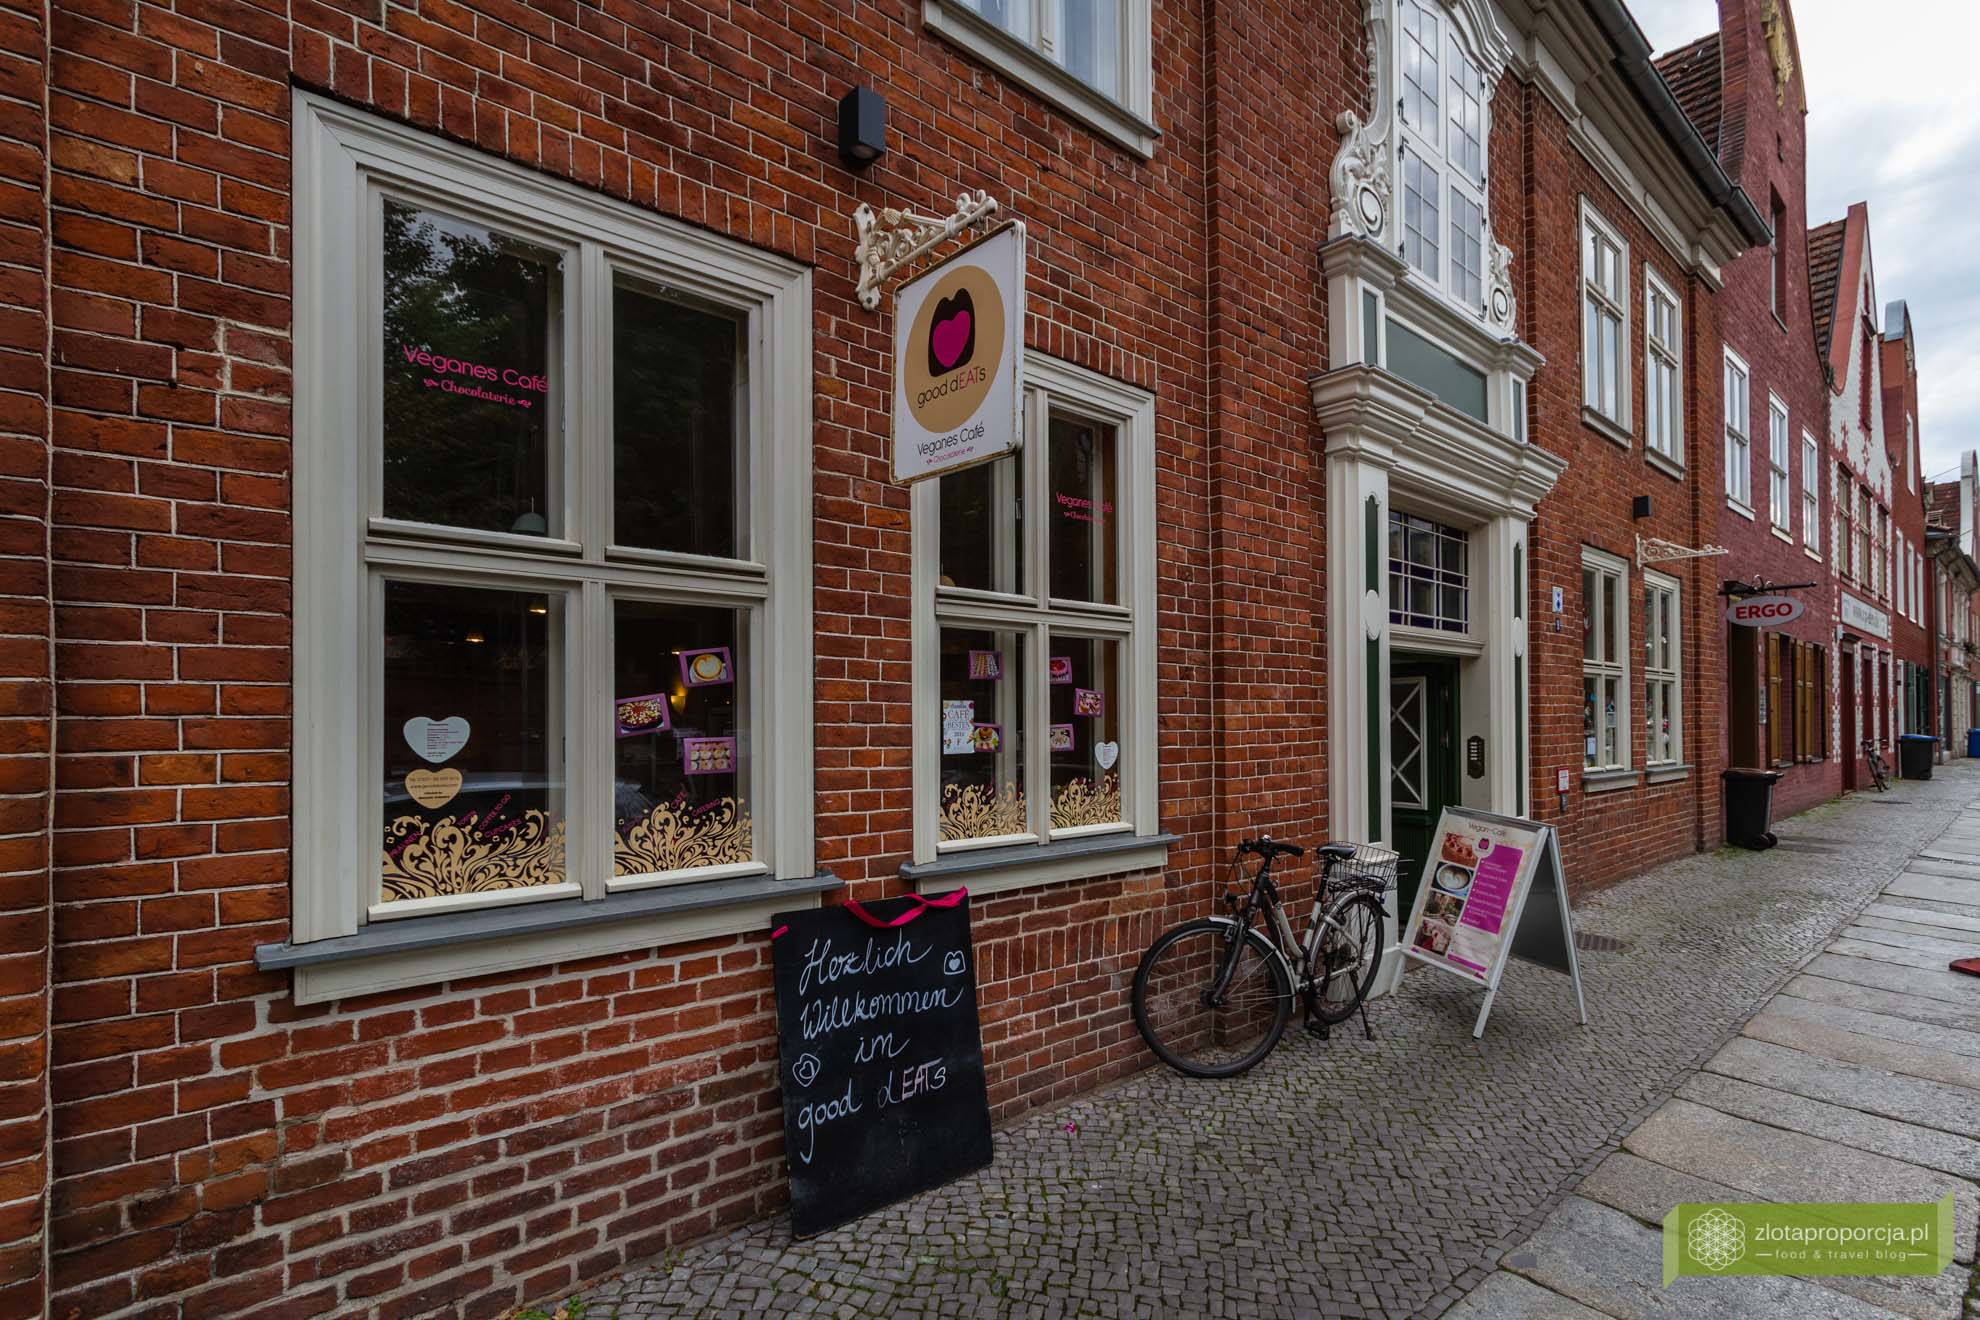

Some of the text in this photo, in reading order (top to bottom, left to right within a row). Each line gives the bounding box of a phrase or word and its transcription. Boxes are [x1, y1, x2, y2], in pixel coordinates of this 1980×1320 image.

[402, 344, 549, 393] Veganes Café
[441, 379, 516, 406] Chocolaterie
[917, 379, 948, 409] good
[917, 420, 985, 456] Veganes Café
[1735, 602, 1793, 620] ERGO
[799, 927, 934, 996] Herzlich
[800, 986, 964, 1041] Willkommen
[855, 1031, 910, 1063] im
[798, 1077, 863, 1164] good
